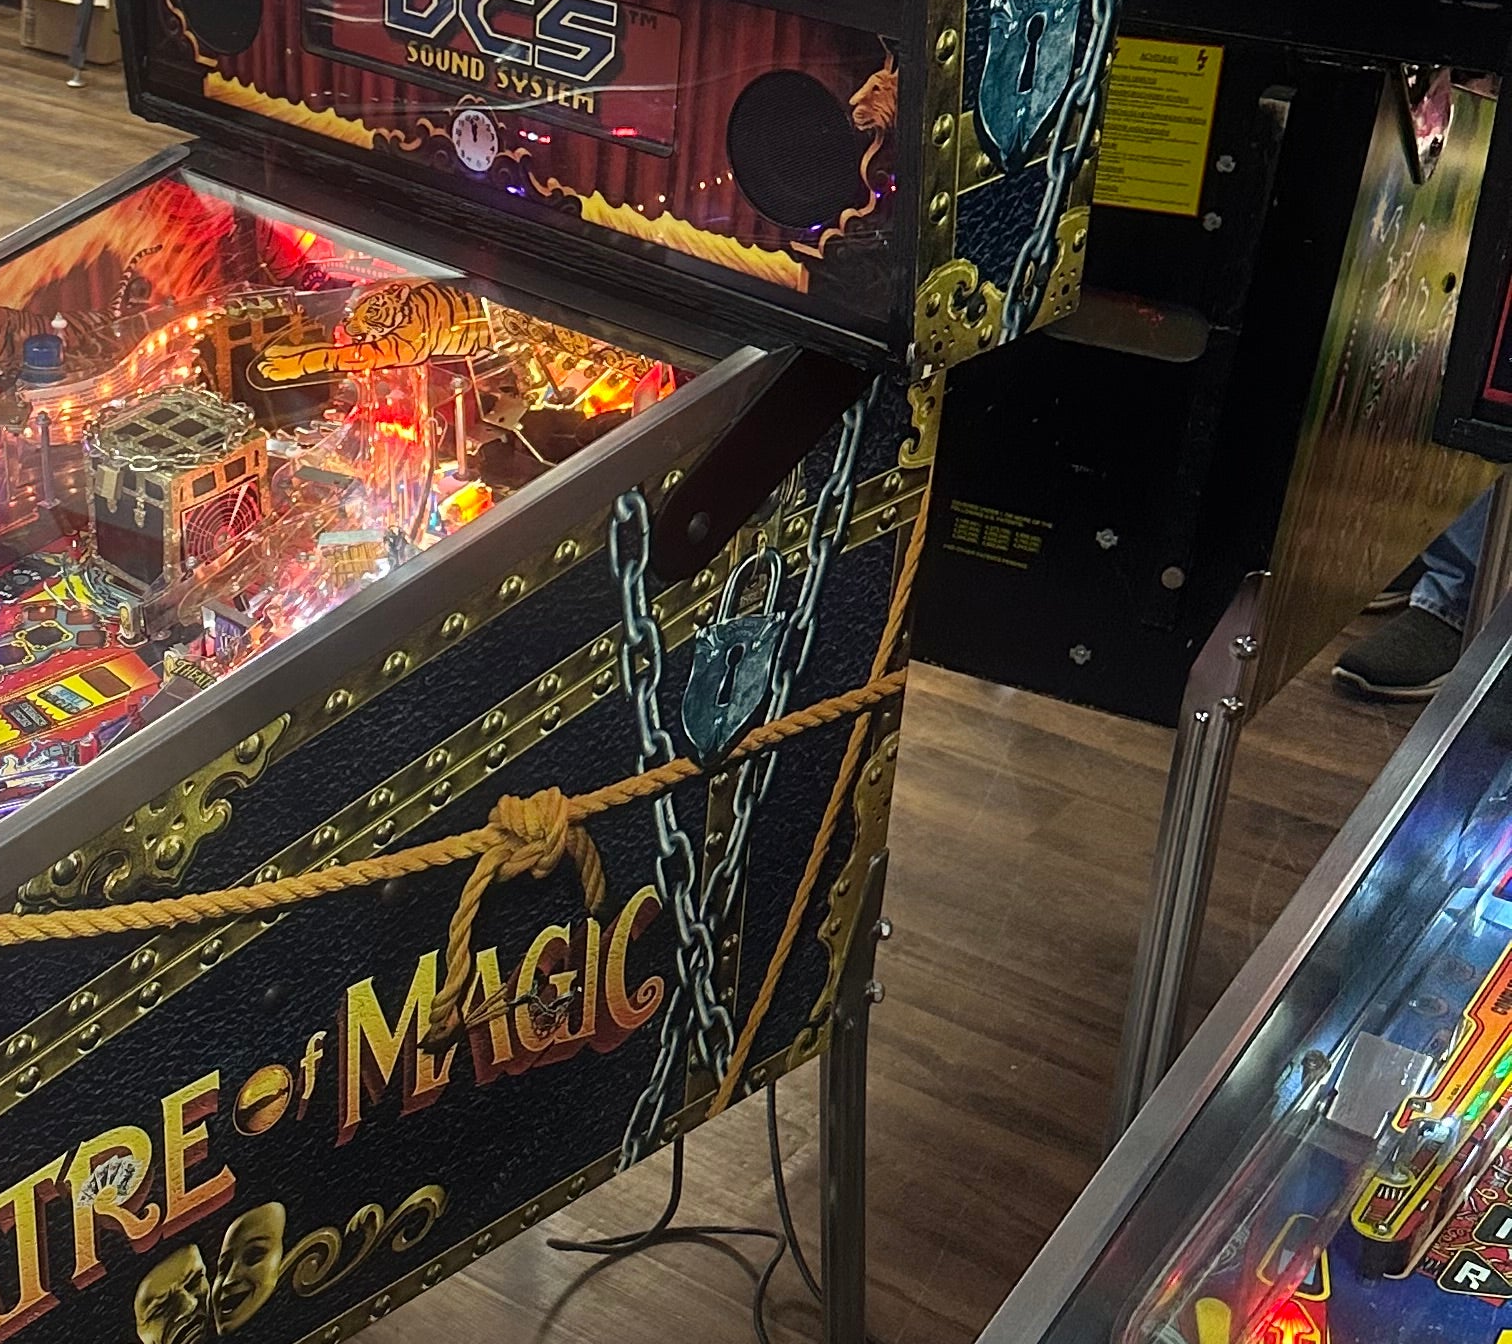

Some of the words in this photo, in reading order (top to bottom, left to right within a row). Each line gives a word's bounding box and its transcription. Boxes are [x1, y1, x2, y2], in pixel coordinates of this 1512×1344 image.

[406, 43, 486, 84] SOUND
[496, 61, 596, 116] SYSTEM
[232, 1026, 327, 1141] of
[332, 883, 666, 1150] MAGIC
